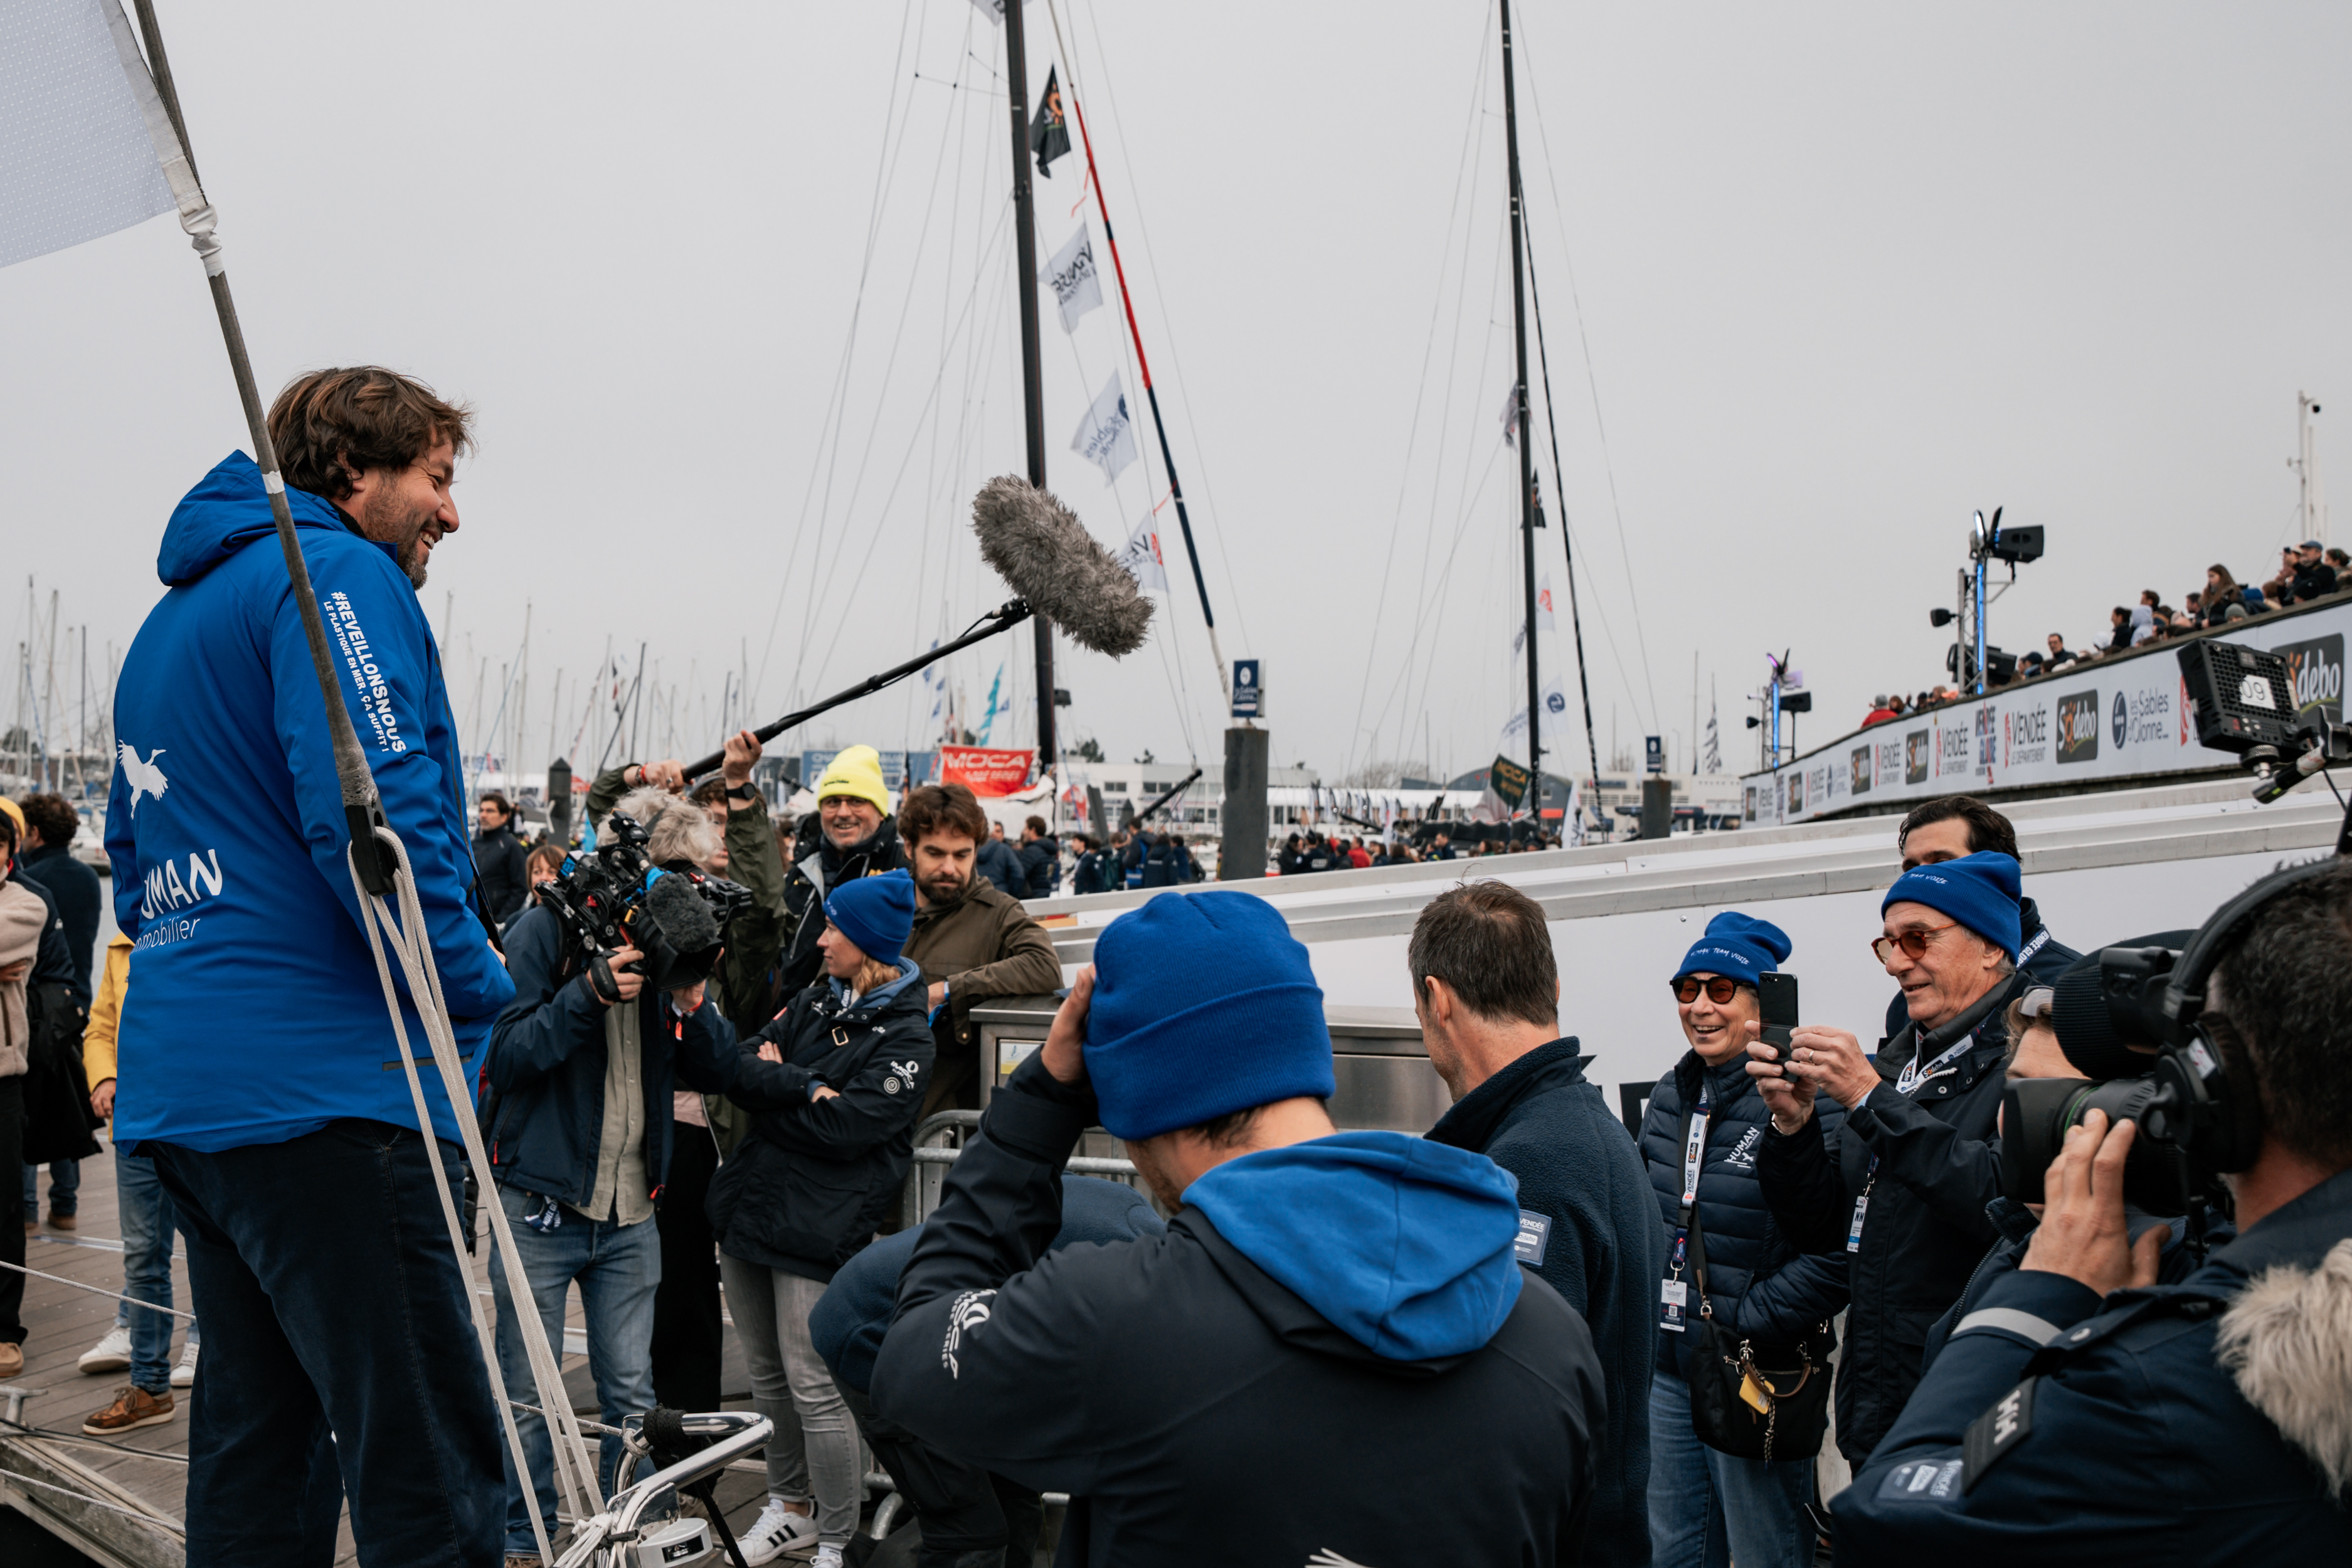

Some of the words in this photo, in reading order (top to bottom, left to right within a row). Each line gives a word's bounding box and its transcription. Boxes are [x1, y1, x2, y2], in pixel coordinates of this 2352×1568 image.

[323, 601, 334, 612] LE
[328, 612, 353, 656] PLASTIQUE
[331, 591, 407, 753] #REVEILLONSNOUS
[347, 657, 358, 669] EN
[2291, 649, 2341, 704] debo
[360, 695, 373, 711] ÇA
[2139, 687, 2169, 718] Sables
[2241, 681, 2265, 701] 09
[368, 712, 388, 746] SUFFIT
[1942, 721, 1968, 758] VENDÉE
[2011, 702, 2047, 746] VENDÉE
[2057, 699, 2097, 751] Sodebo
[141, 849, 223, 920] UMAN
[132, 915, 201, 953] mmobilier
[1712, 947, 1730, 957] TEAM
[1730, 952, 1750, 965] VOILE
[2016, 946, 2034, 968] GLOB
[890, 1060, 915, 1089] IMOCA
[1922, 1062, 1943, 1078] Sodebo
[1724, 1126, 1758, 1163] HUMAN
[1519, 1217, 1545, 1230] VENDÉE
